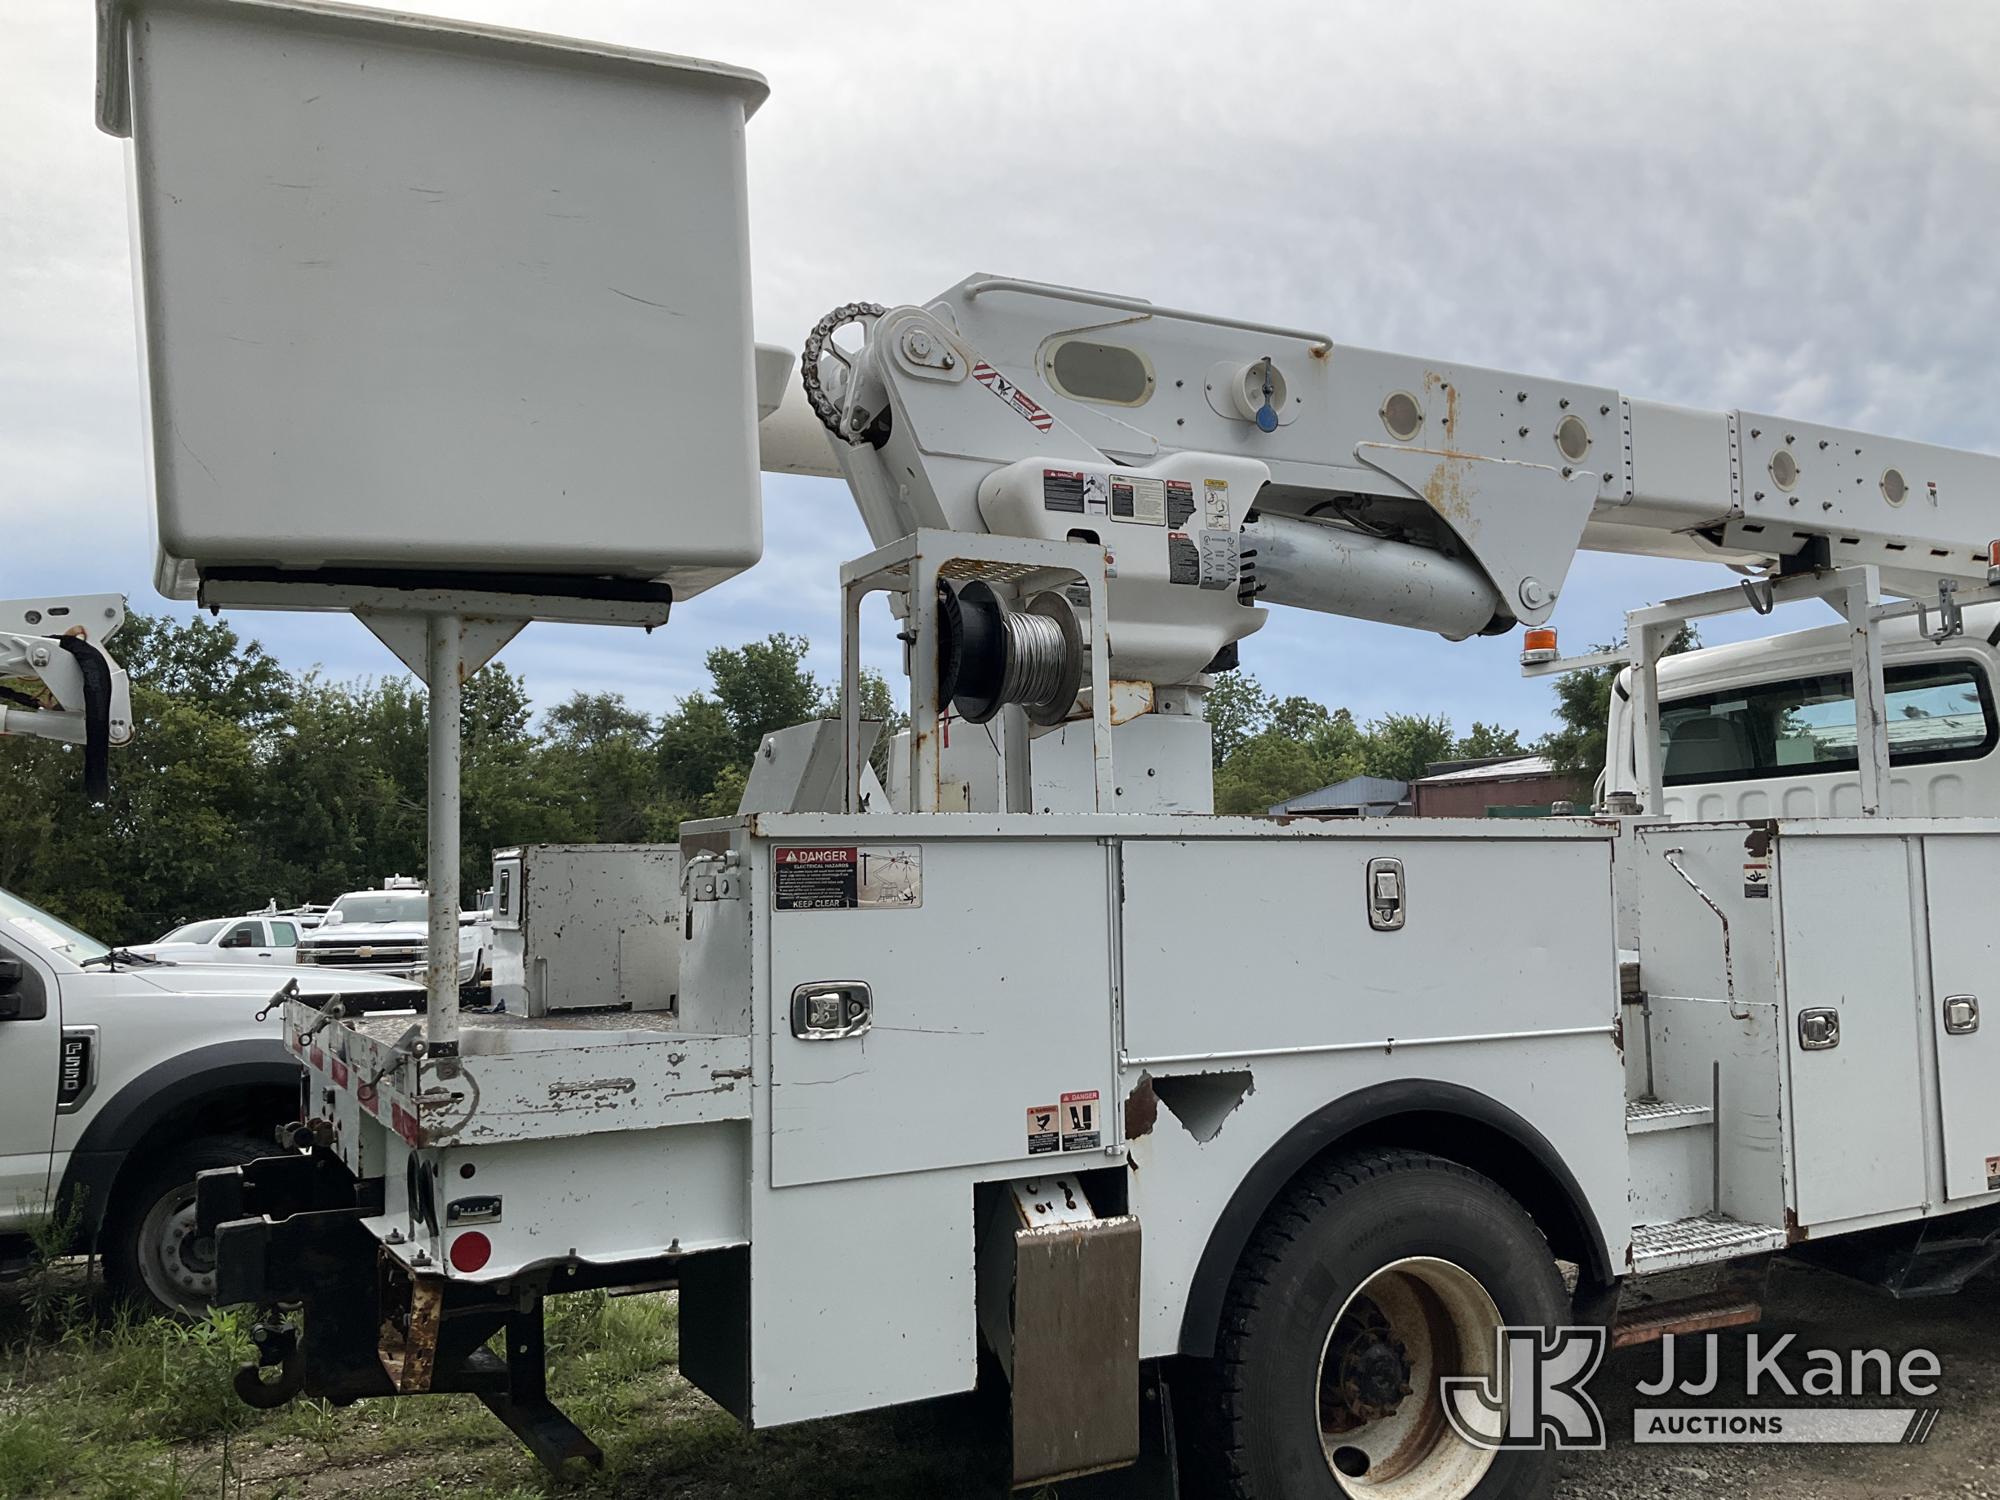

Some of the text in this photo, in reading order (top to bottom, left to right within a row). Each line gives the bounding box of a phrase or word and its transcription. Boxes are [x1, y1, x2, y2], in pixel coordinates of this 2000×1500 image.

[799, 850, 847, 863] DANGER
[792, 899, 840, 908] KEEP CLEAR
[63, 1042, 82, 1091] F550
[1071, 1091, 1097, 1101] DANGER
